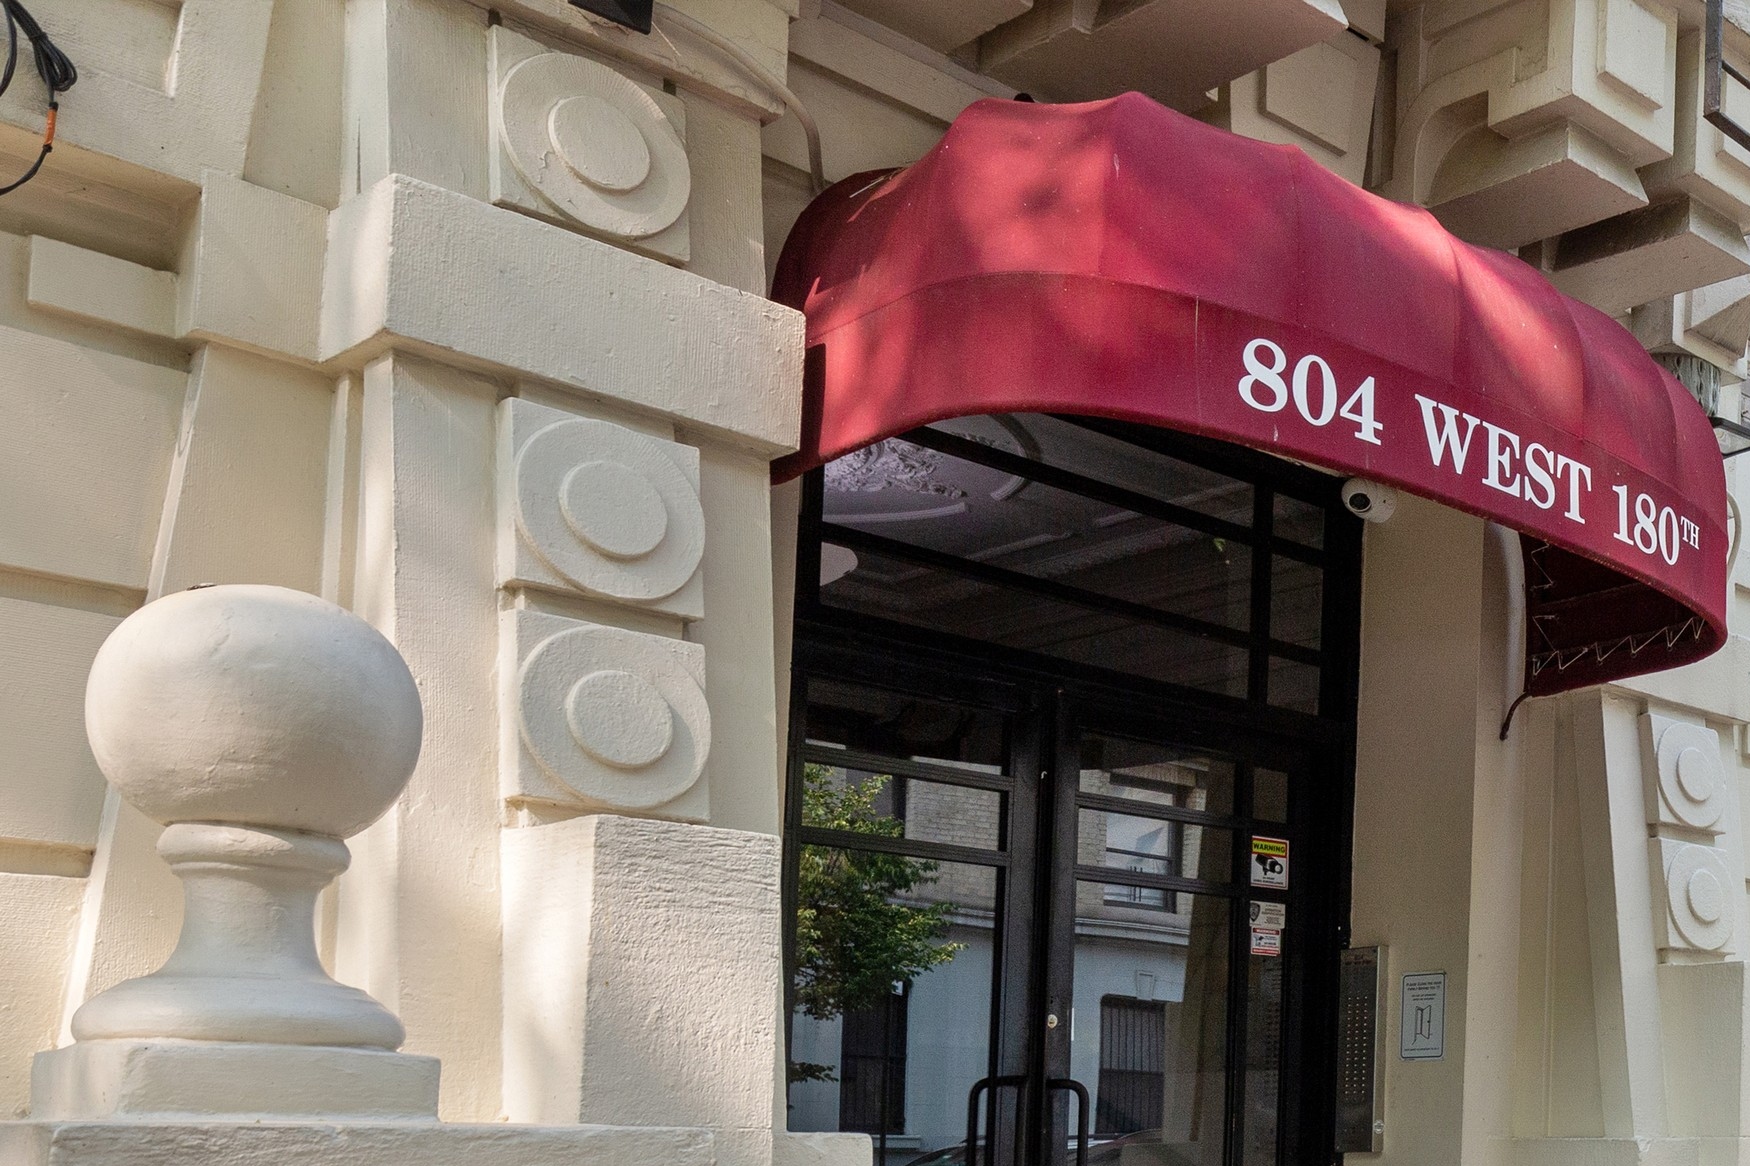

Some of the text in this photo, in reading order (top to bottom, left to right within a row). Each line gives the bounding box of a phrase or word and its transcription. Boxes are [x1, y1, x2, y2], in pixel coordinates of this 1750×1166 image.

[1237, 337, 1384, 446] 804
[1414, 393, 1593, 525] WEST
[1252, 842, 1286, 853] WARNING
